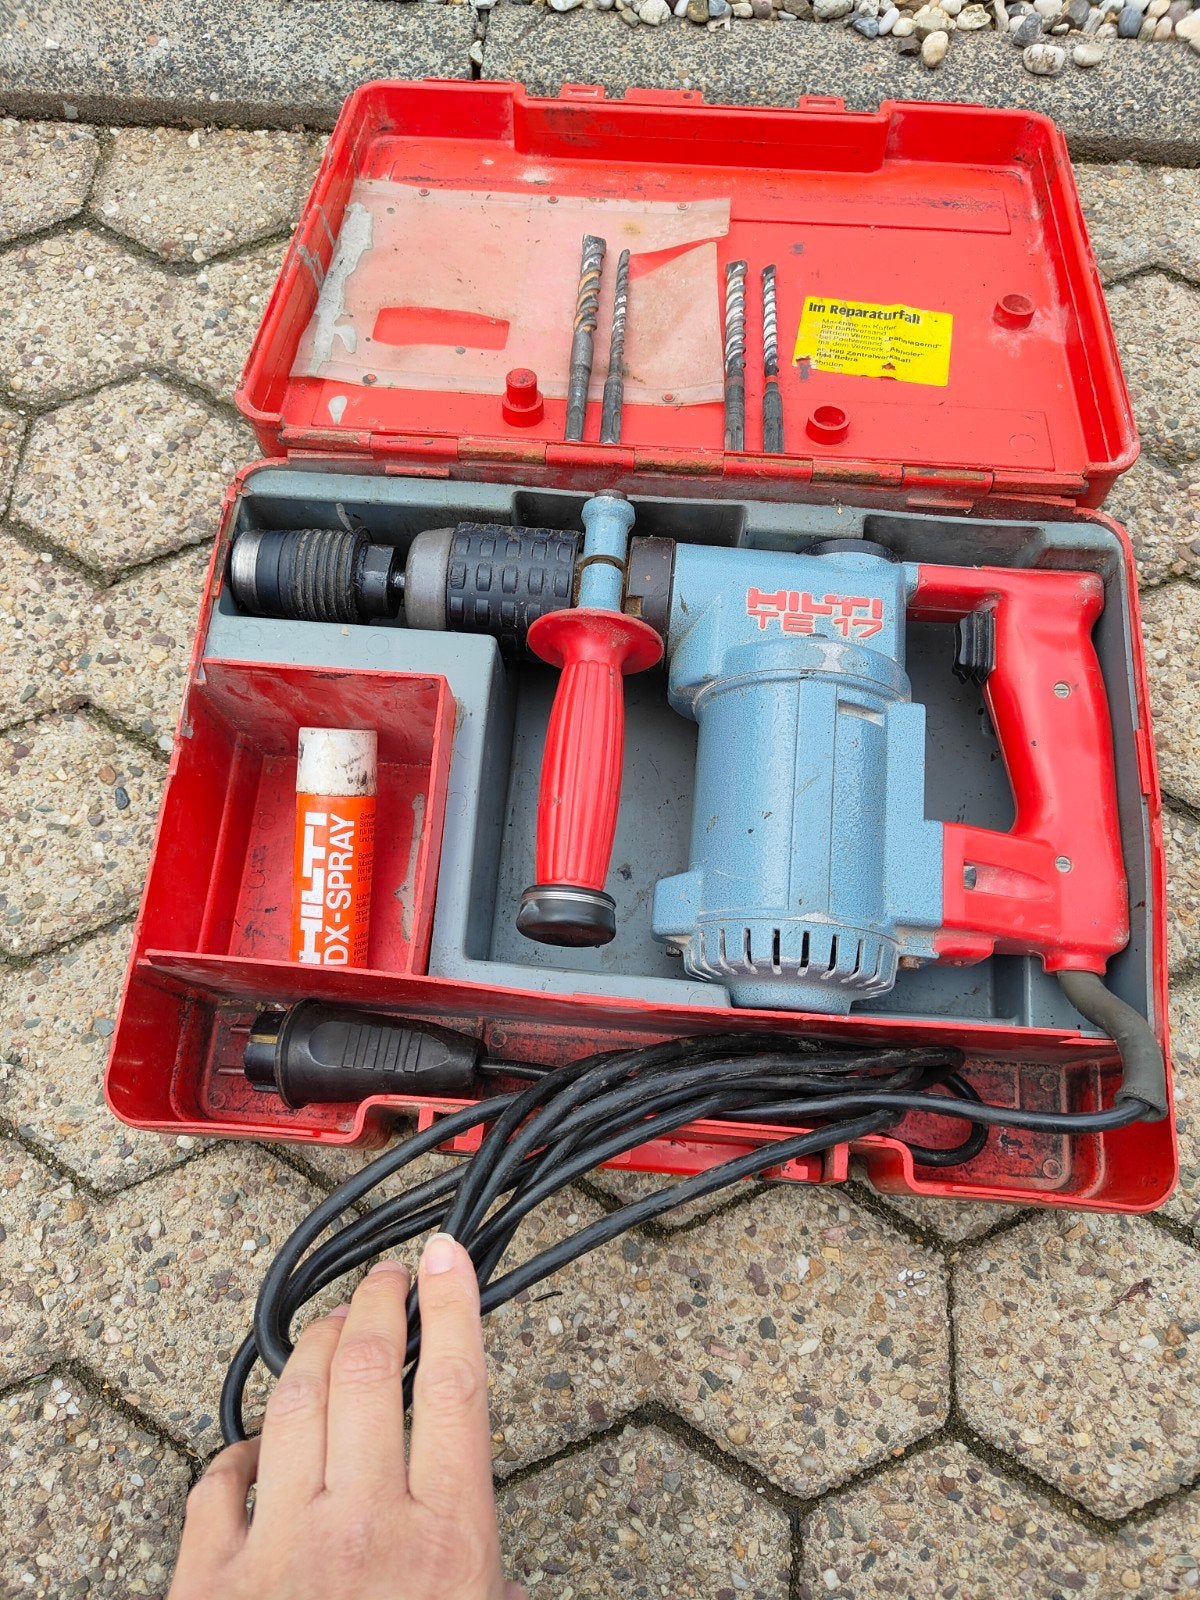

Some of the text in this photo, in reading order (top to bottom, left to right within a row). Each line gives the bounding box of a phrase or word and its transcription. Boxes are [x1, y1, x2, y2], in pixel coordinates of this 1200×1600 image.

[808, 302, 920, 324] Im Reparaturfall
[747, 586, 883, 620] HILTI
[747, 609, 883, 638] TE 17
[299, 811, 328, 966] HILTI
[323, 812, 355, 967] DX-SPRAY
